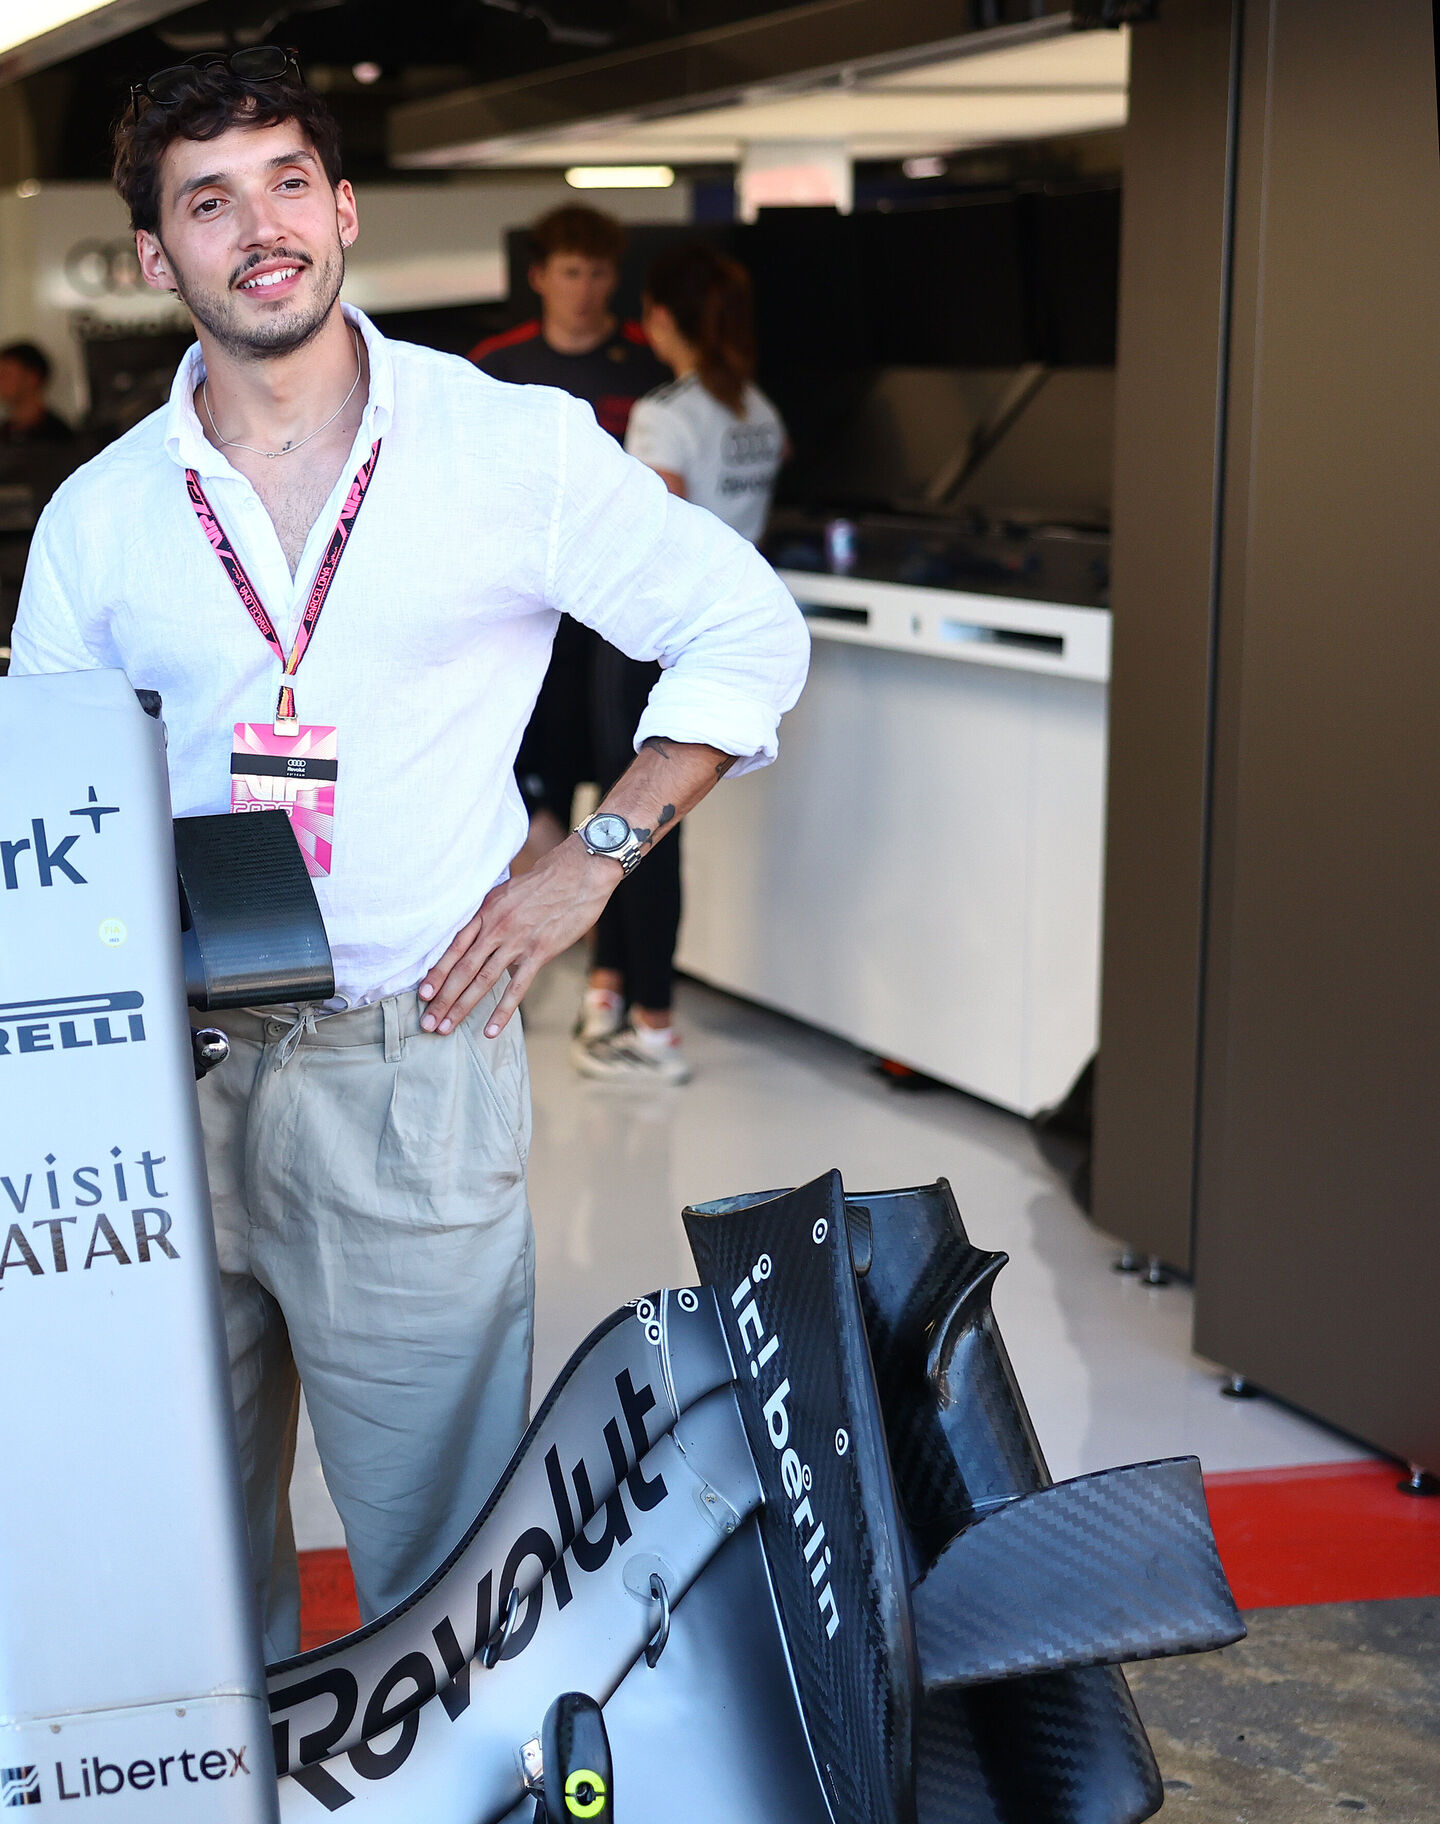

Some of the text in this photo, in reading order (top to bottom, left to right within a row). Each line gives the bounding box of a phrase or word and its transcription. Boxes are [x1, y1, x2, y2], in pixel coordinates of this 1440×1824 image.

[239, 585, 271, 636] BARCELONA
[305, 566, 332, 622] BARCELONA
[0, 1146, 170, 1213] visit
[763, 1377, 840, 1641] berlin
[266, 1368, 669, 1812] Revolut
[55, 1745, 250, 1801] Libertex
